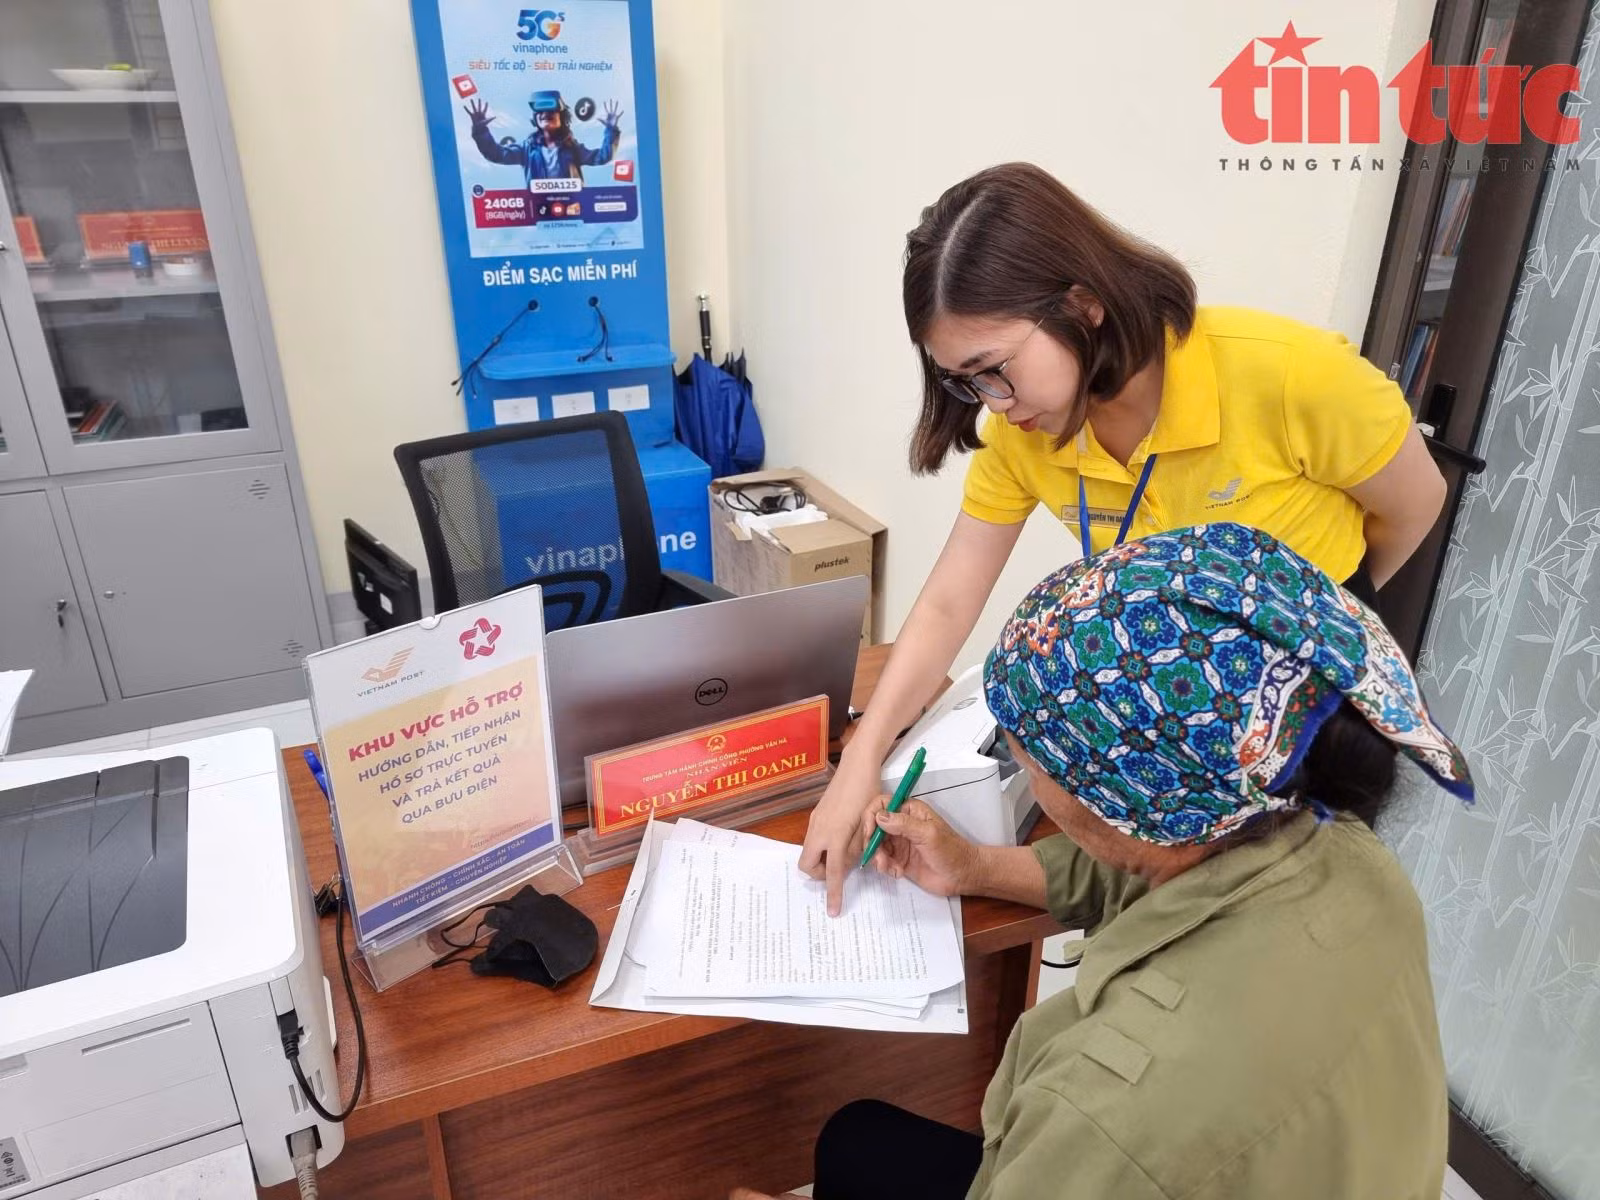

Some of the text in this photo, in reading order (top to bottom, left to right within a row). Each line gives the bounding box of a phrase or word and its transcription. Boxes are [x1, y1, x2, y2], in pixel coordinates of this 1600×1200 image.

[512, 43, 568, 55] vinaphone
[468, 60, 491, 70] SIÊU
[493, 59, 510, 70] TỐC
[513, 60, 526, 73] ĐỘ
[533, 60, 555, 71] SIÊU
[557, 59, 577, 71] TRẢI
[579, 60, 613, 73] NGHIỆM
[535, 181, 577, 191] SODA125
[484, 197, 525, 210] 240GB
[483, 258, 637, 286] ĐIỂM SẠC MIỄN PHÍ
[814, 556, 849, 572] plustek
[358, 671, 425, 697] VIETNAM POST
[349, 680, 524, 762] KHU VỰC HỖ TRỢ
[358, 709, 521, 782] HƯỚNG DẪN, TIẾP NHẬN
[380, 733, 508, 794] HỒ SƠ TRỰC TUYẾN
[642, 772, 663, 783] TRUNG
[664, 767, 679, 777] TÂM
[392, 754, 501, 808] VÀ TRẢ KẾT QUẢ
[620, 752, 807, 818] NGUYỄN THỊ OANH
[402, 775, 498, 824] QUA BƯU ĐIỆN
[392, 891, 419, 908] NHANH
